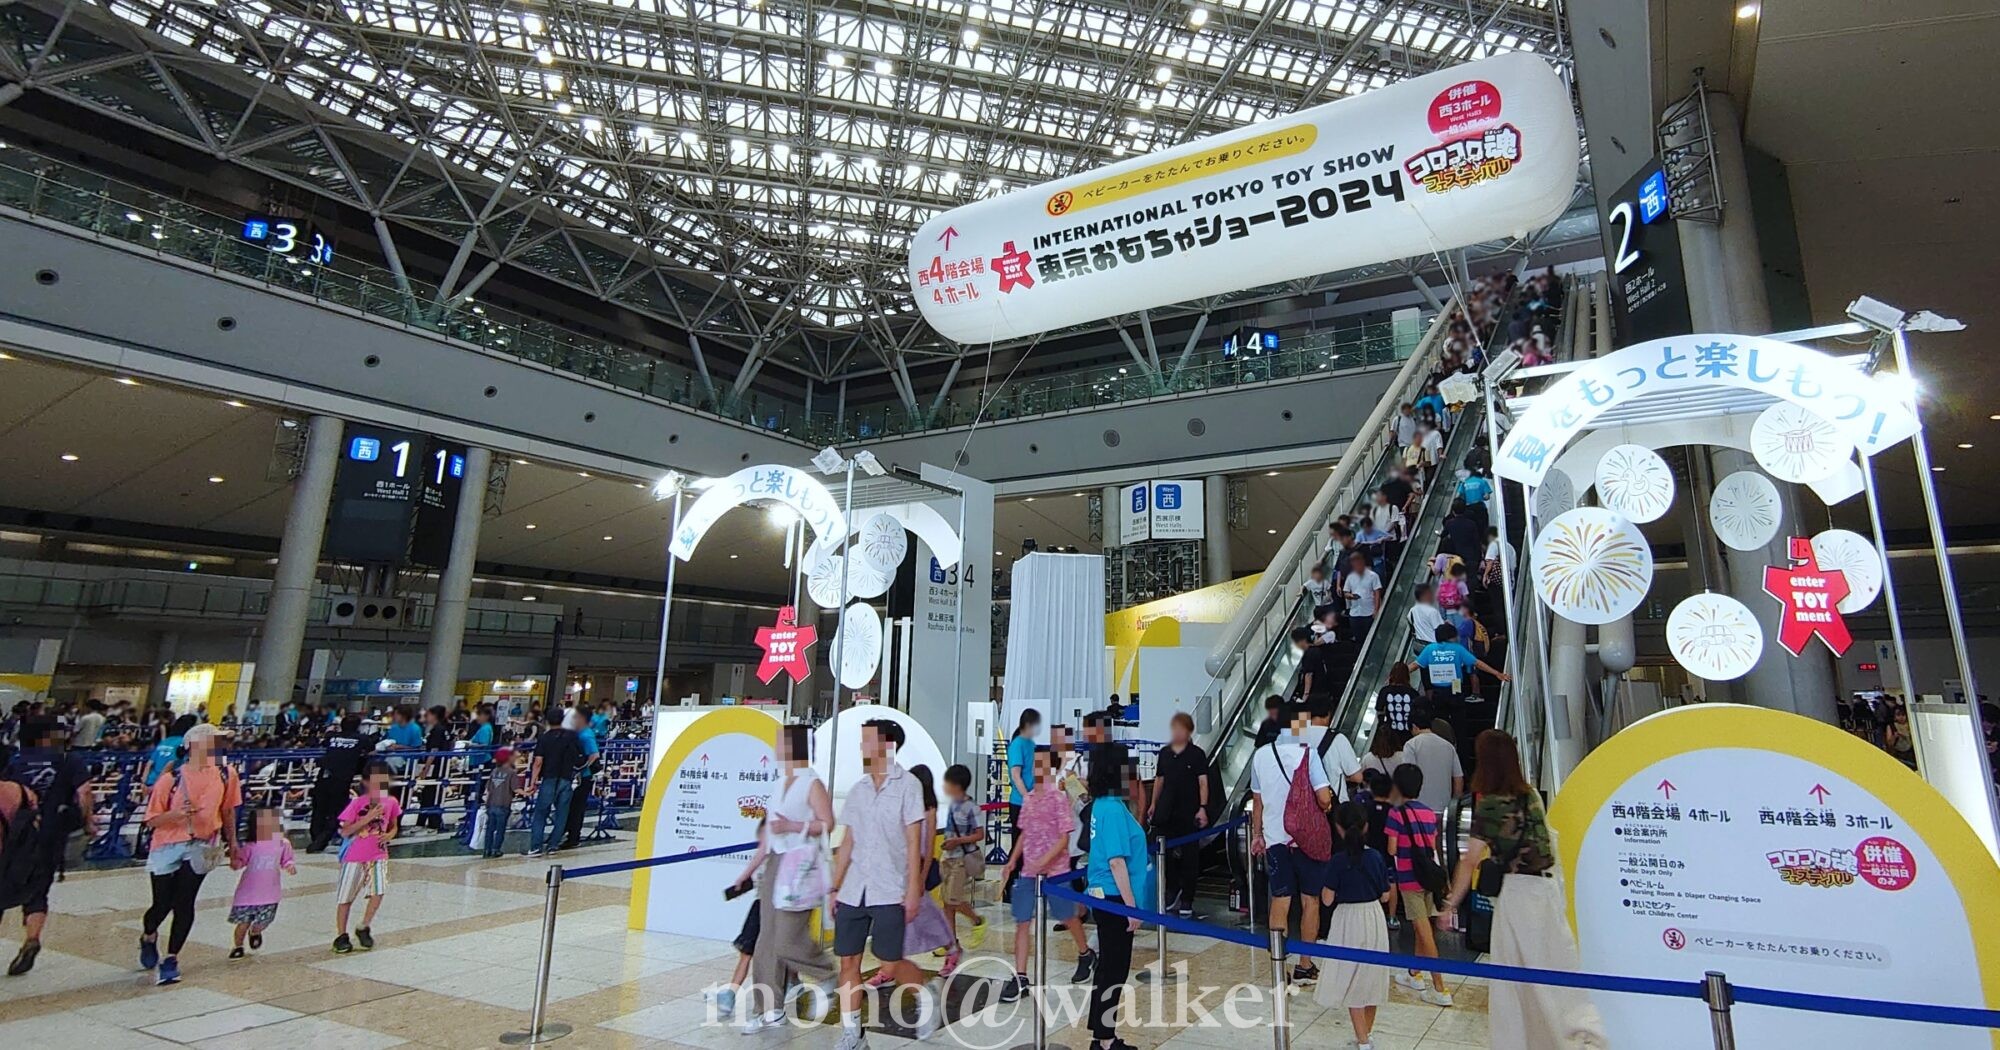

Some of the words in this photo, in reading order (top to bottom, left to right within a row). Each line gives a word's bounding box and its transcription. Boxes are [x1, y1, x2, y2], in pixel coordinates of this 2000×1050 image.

[1448, 84, 1477, 100] 併催
[1439, 95, 1492, 118] 西3ホール
[1083, 136, 1306, 199] ベビーカーをたたんでお乗りください。
[1033, 201, 1188, 250] INTERNATIONAL
[1191, 179, 1264, 209] TOKYO
[1272, 165, 1315, 190] TOY
[1323, 144, 1395, 177] SHOW
[1035, 169, 1406, 285] 東京おもちゃショー2024
[272, 223, 298, 252] 3
[1608, 201, 1641, 275] 2
[310, 233, 325, 263] 3
[917, 255, 984, 287] 西4階会場
[1003, 264, 1022, 275] TOY
[1230, 335, 1238, 357] 4
[1246, 332, 1263, 355] 4
[391, 440, 410, 478] 1
[435, 449, 447, 484] 1
[1162, 493, 1175, 508] 西
[963, 564, 975, 589] 4
[1789, 576, 1826, 587] enter
[1792, 591, 1829, 609] TOY
[1795, 611, 1833, 623] ment
[770, 631, 798, 640] enter
[770, 641, 798, 654] TOY
[769, 654, 796, 663] ment
[1612, 804, 1681, 821] 西4階会場
[1688, 808, 1731, 822] 4ホール
[1758, 810, 1837, 828] 西4階会場
[1845, 815, 1893, 830] 3ホール
[1623, 827, 1668, 838] 総合案内所
[1624, 837, 1661, 845] Information
[1618, 857, 1686, 869] 一般公開日のみ
[1863, 845, 1903, 864] 併催
[1658, 869, 1673, 877] Only
[1877, 877, 1898, 886] のみ
[1630, 888, 1655, 897] Nursing
[1656, 890, 1675, 898] Room
[1685, 892, 1706, 900] Diaper
[1708, 894, 1739, 902] Changing
[1694, 937, 1883, 962] ベビーカーをたたんでお乗りください。
